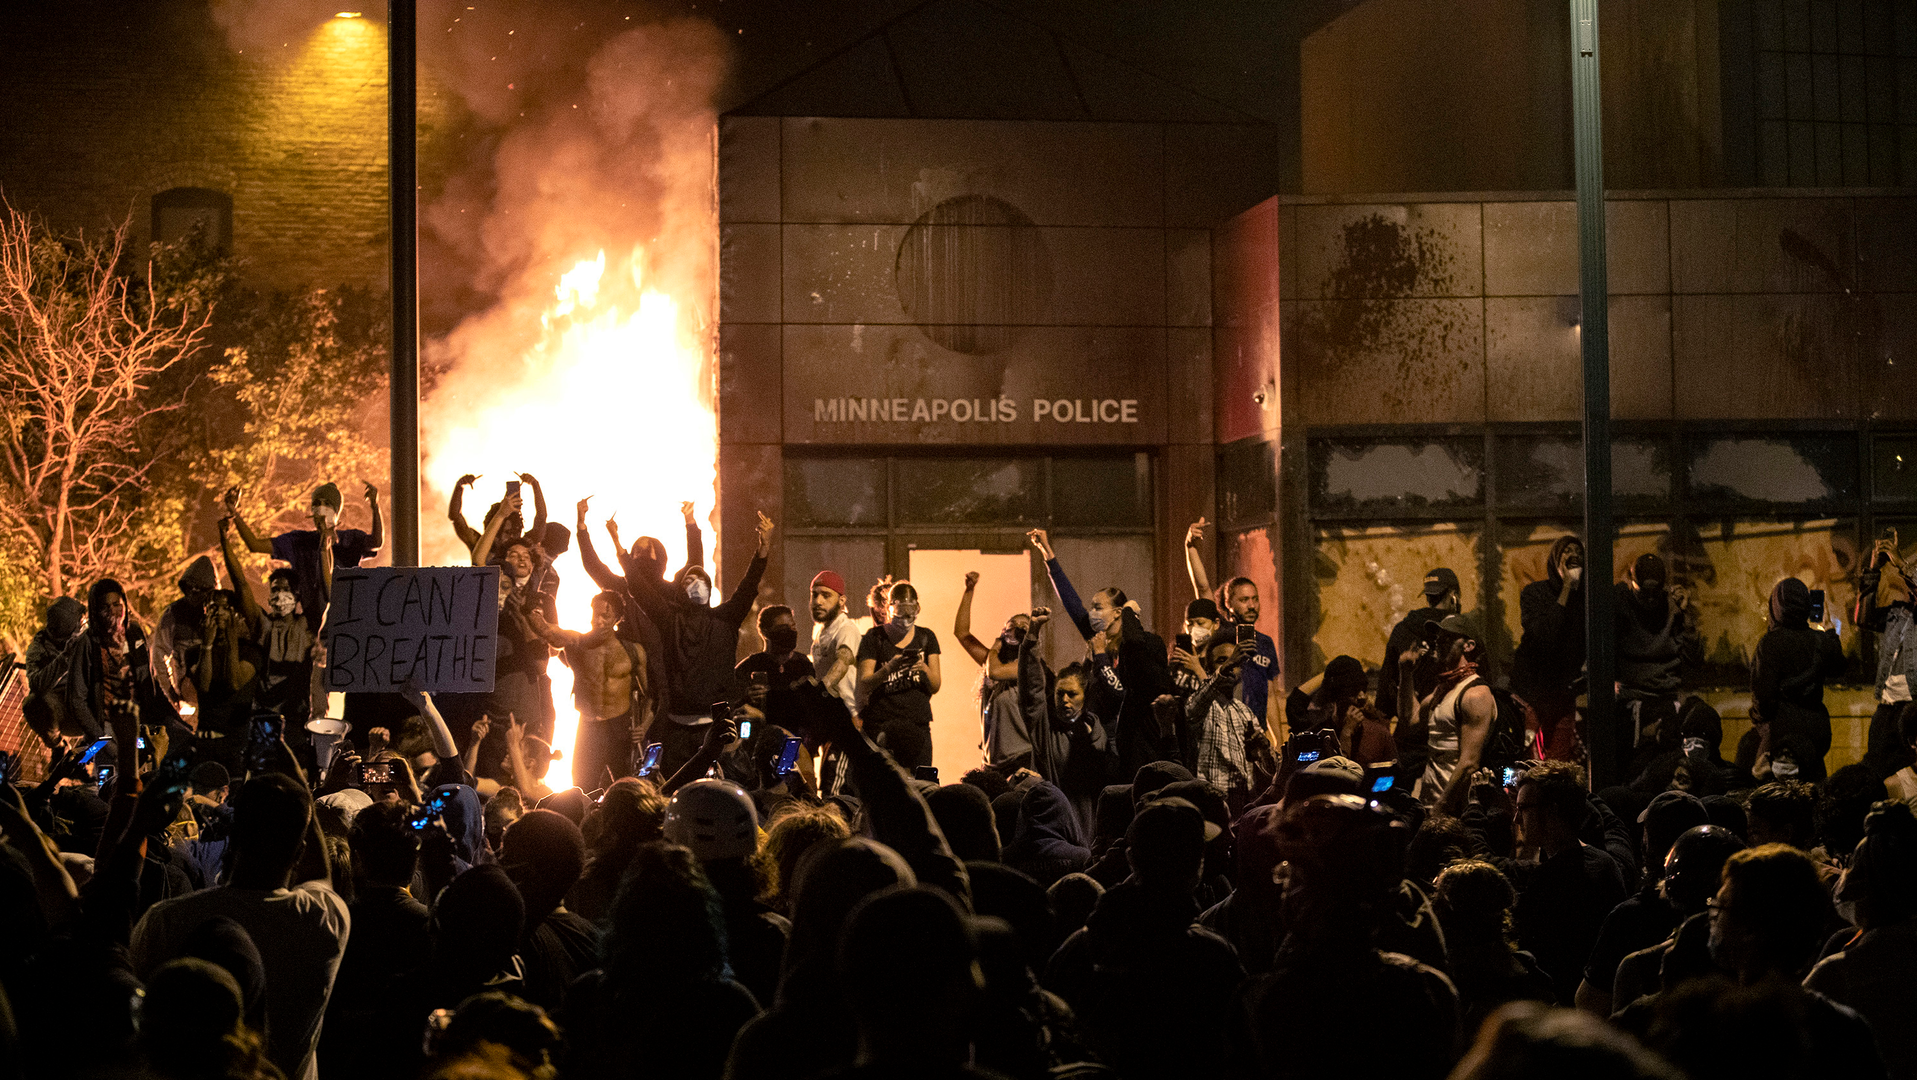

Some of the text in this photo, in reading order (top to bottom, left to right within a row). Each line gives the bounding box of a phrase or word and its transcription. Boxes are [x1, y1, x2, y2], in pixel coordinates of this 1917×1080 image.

[814, 398, 1139, 422] MINNEAPOLIS POLICE
[333, 571, 493, 629] I CAN'T
[330, 632, 490, 687] BREATHE
